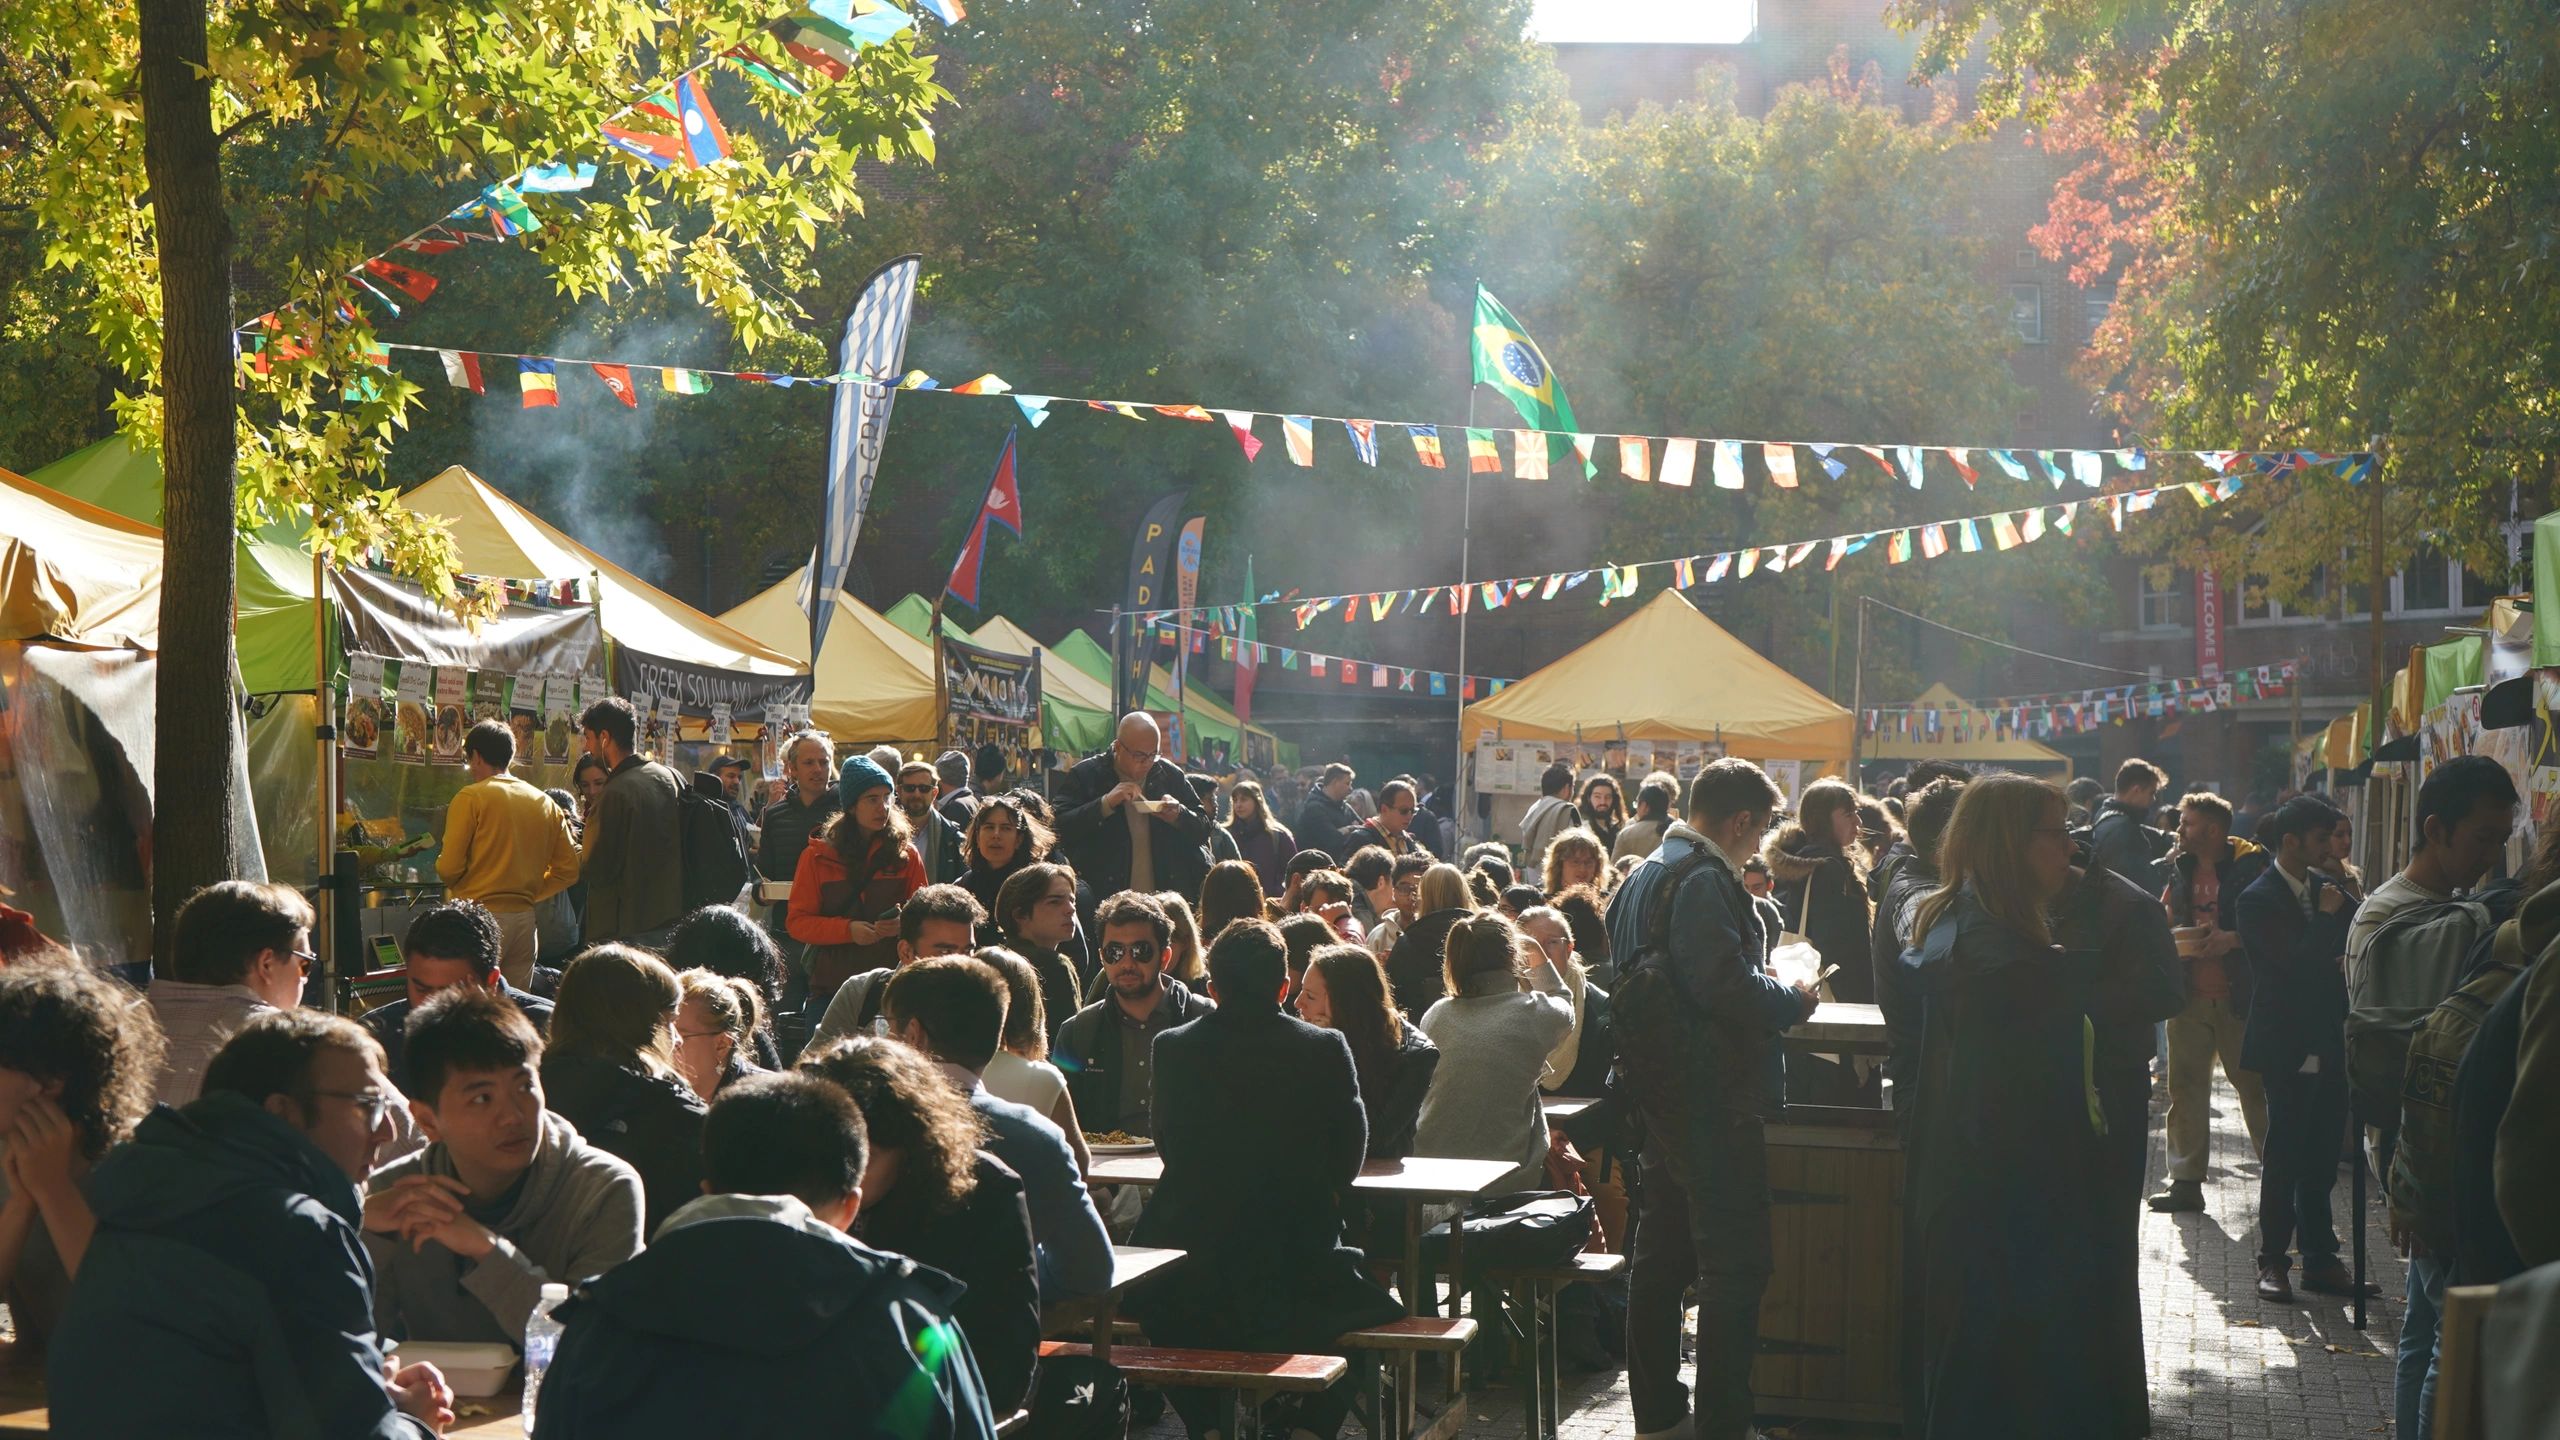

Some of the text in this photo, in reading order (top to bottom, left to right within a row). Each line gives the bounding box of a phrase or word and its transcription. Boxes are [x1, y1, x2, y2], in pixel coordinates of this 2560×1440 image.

[1138, 523, 1163, 606] PAD
[2203, 564, 2216, 657] WELCOME
[352, 670, 381, 683] Combo Meal
[639, 662, 683, 704] GREEK
[1128, 628, 1145, 711] THA
